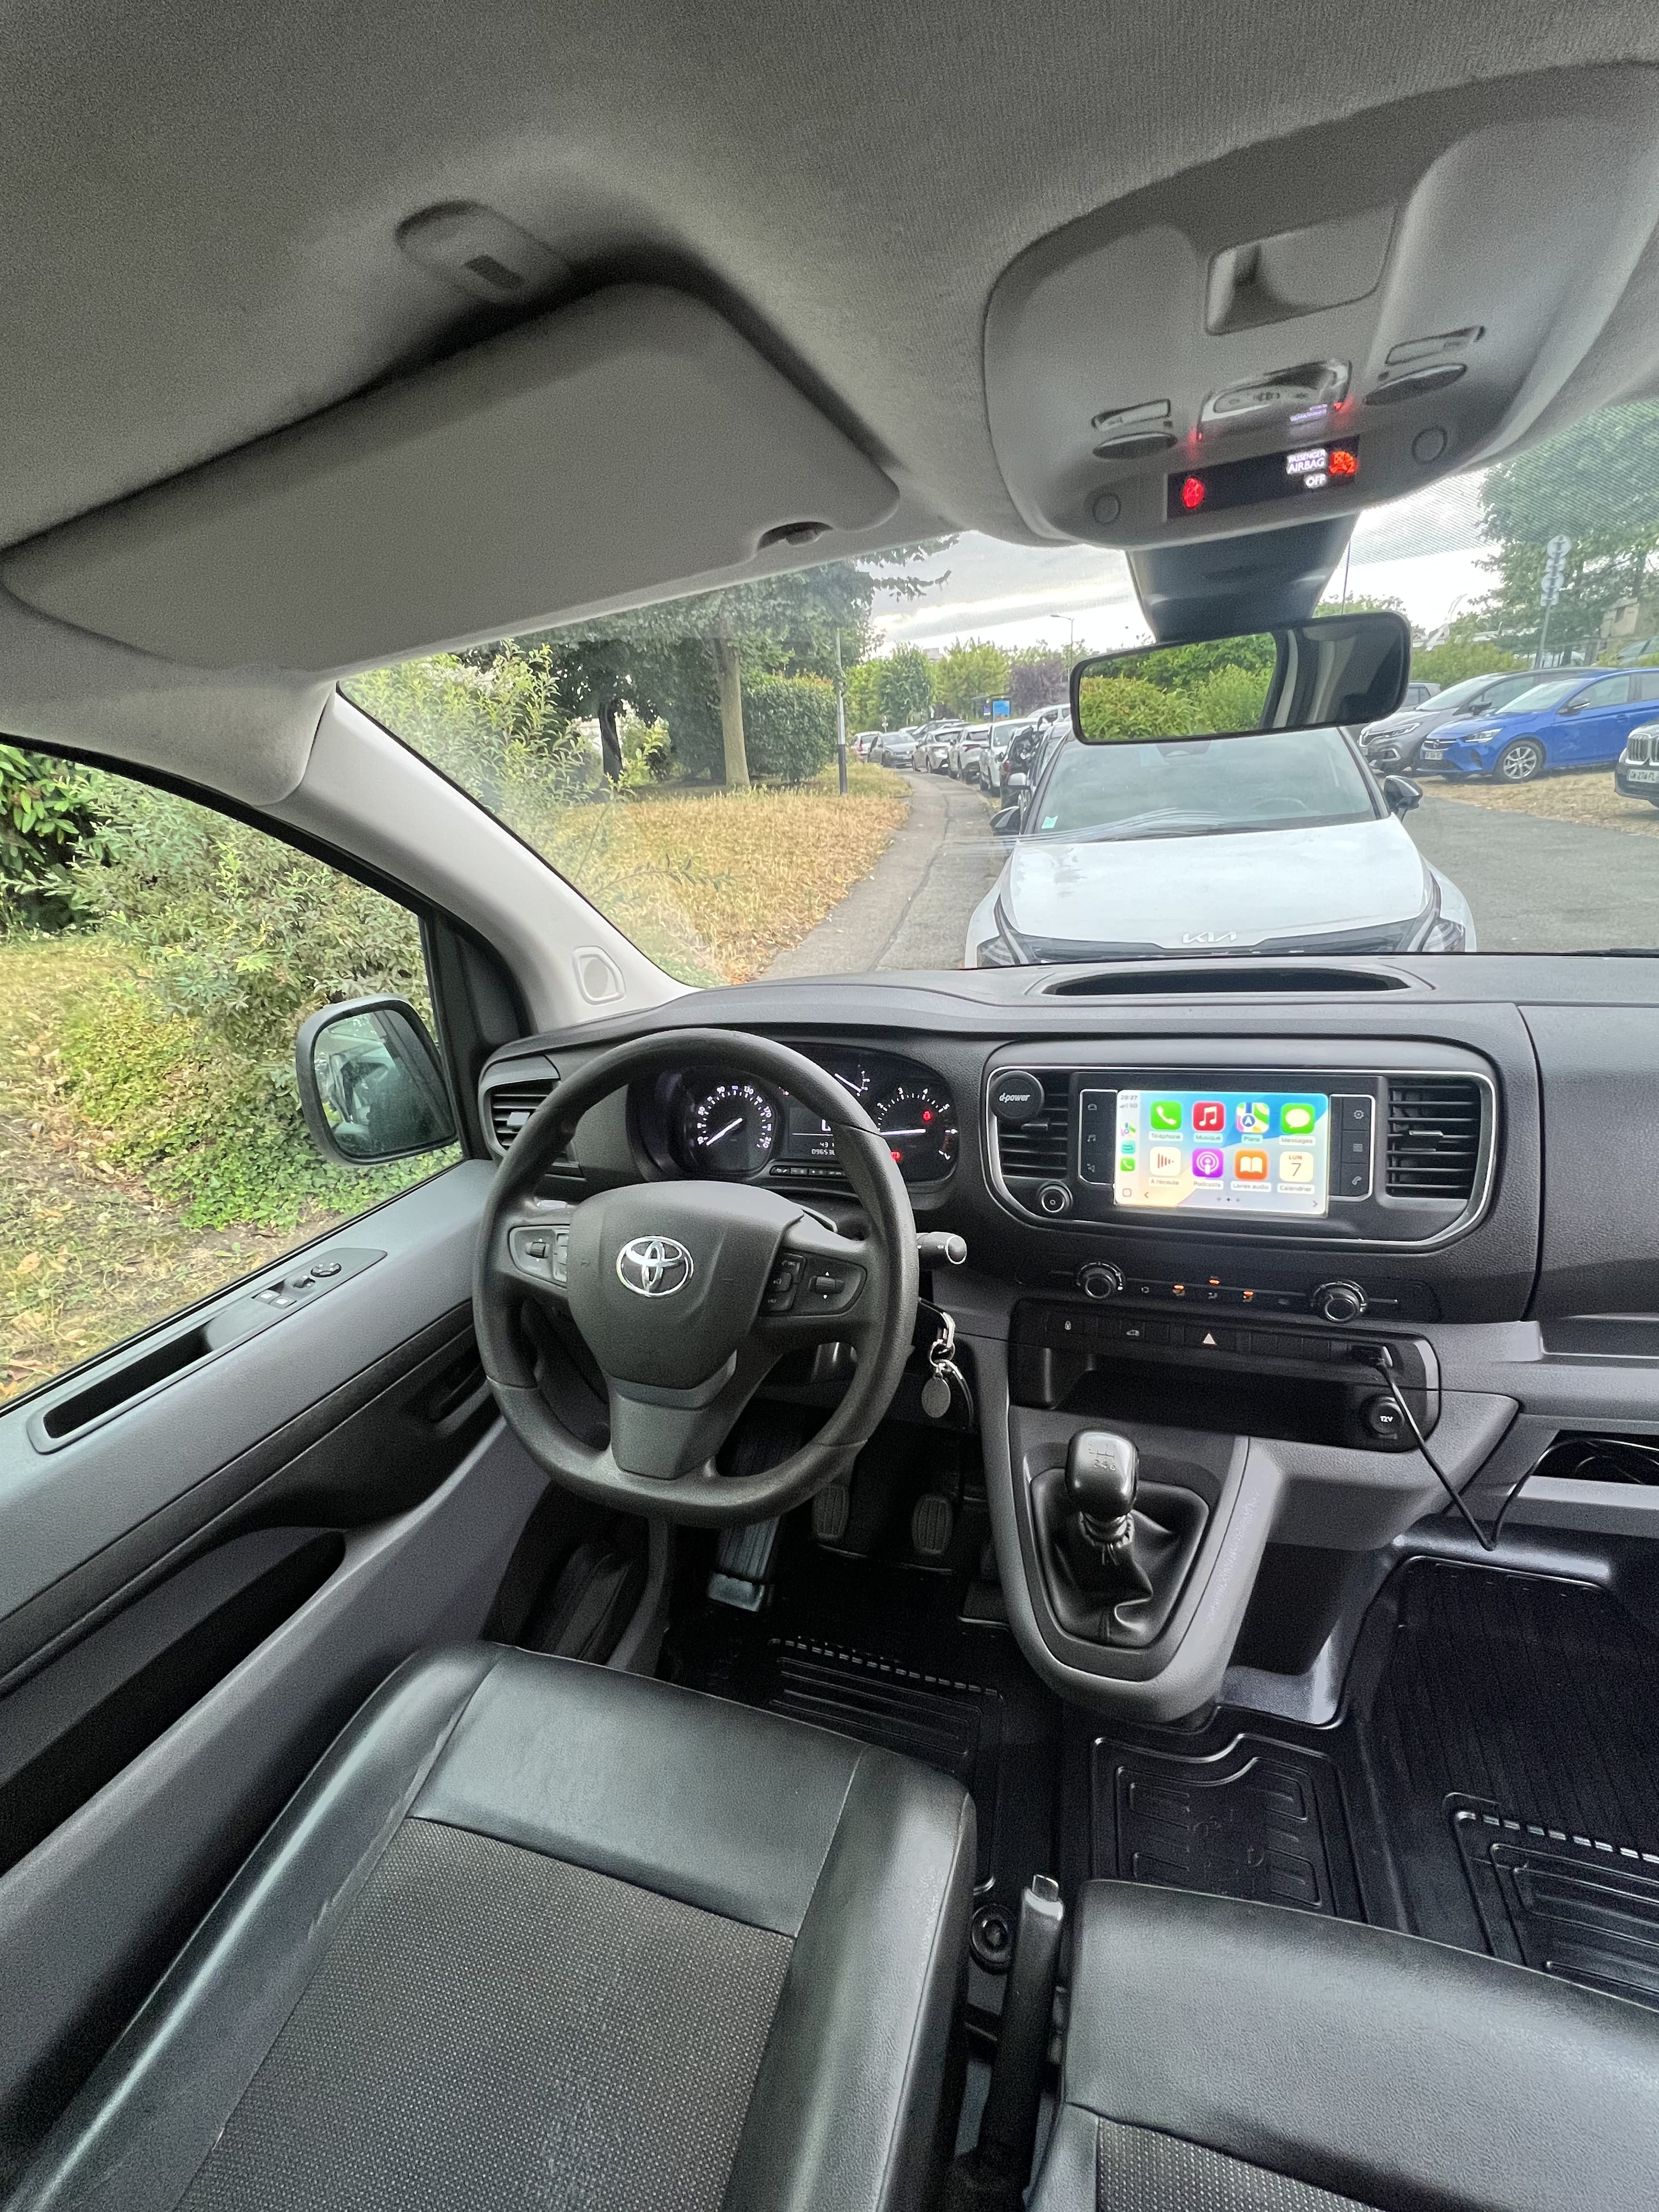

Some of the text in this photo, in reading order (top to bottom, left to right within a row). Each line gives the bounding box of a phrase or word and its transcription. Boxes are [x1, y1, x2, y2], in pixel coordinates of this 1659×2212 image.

[1287, 458, 1325, 473] AIRBAG
[1306, 474, 1326, 487] OFF
[1182, 931, 1237, 944] KIA
[744, 1086, 754, 1095] 130
[1291, 1163, 1302, 1177] 7
